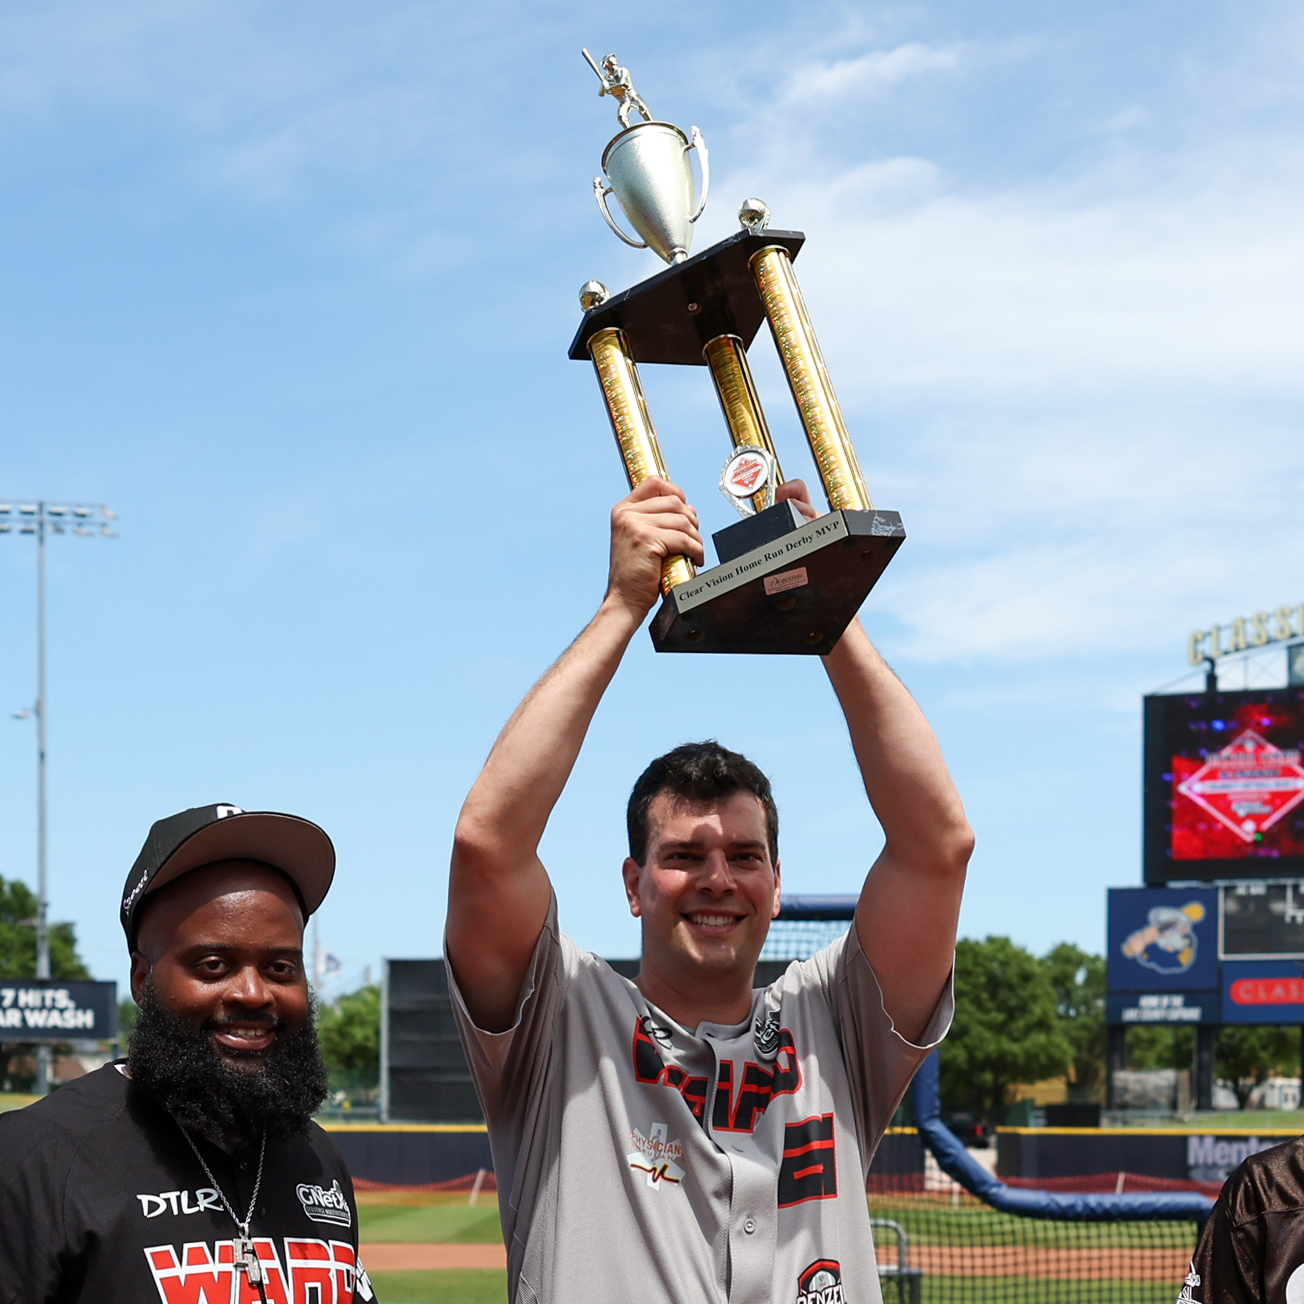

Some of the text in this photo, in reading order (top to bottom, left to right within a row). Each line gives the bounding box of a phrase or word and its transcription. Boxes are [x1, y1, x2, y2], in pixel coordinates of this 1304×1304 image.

[679, 520, 840, 602] Clear Vision Home Run Derby MVP
[0, 988, 16, 1008] 7
[21, 1008, 94, 1029] WASH
[630, 1131, 685, 1157] PHYSICIANS
[136, 1187, 225, 1219] DTLR
